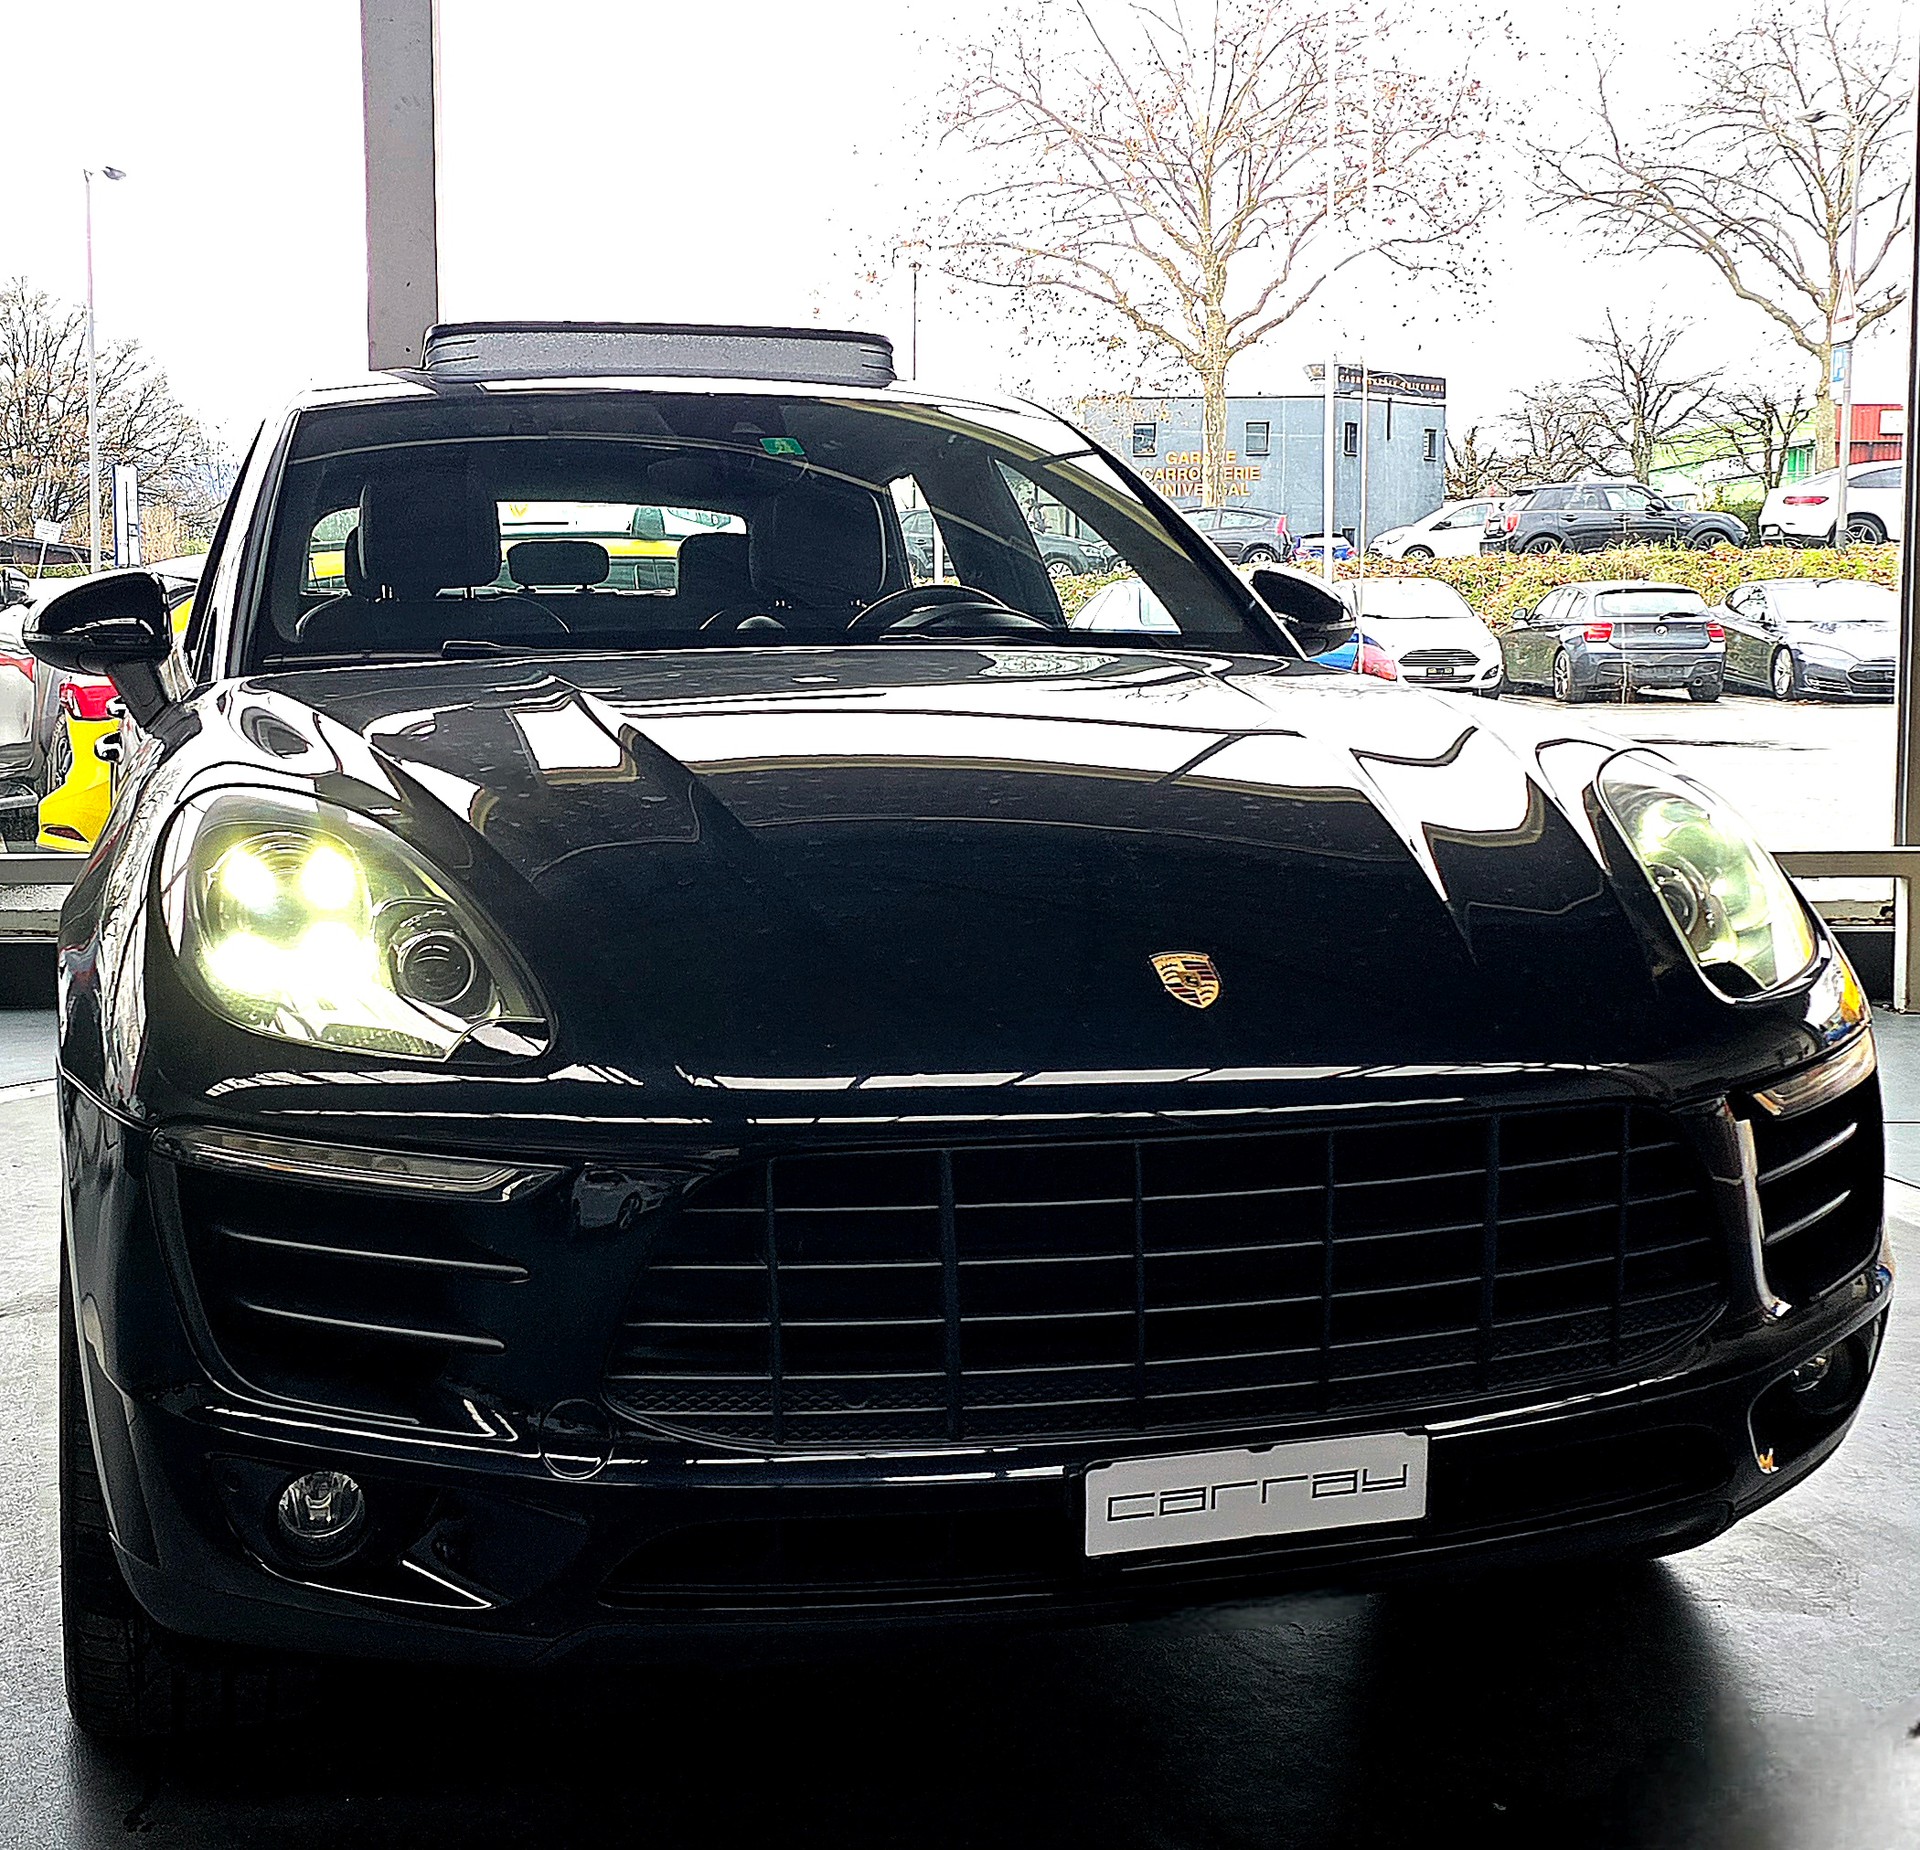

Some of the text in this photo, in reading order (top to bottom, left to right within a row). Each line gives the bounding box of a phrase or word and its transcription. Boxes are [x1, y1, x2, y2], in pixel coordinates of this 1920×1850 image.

[1165, 450, 1237, 465] GARE
[1141, 466, 1261, 481] CARROERIE
[1153, 482, 1251, 497] UNIVESAL
[1106, 1463, 1409, 1522] carray
